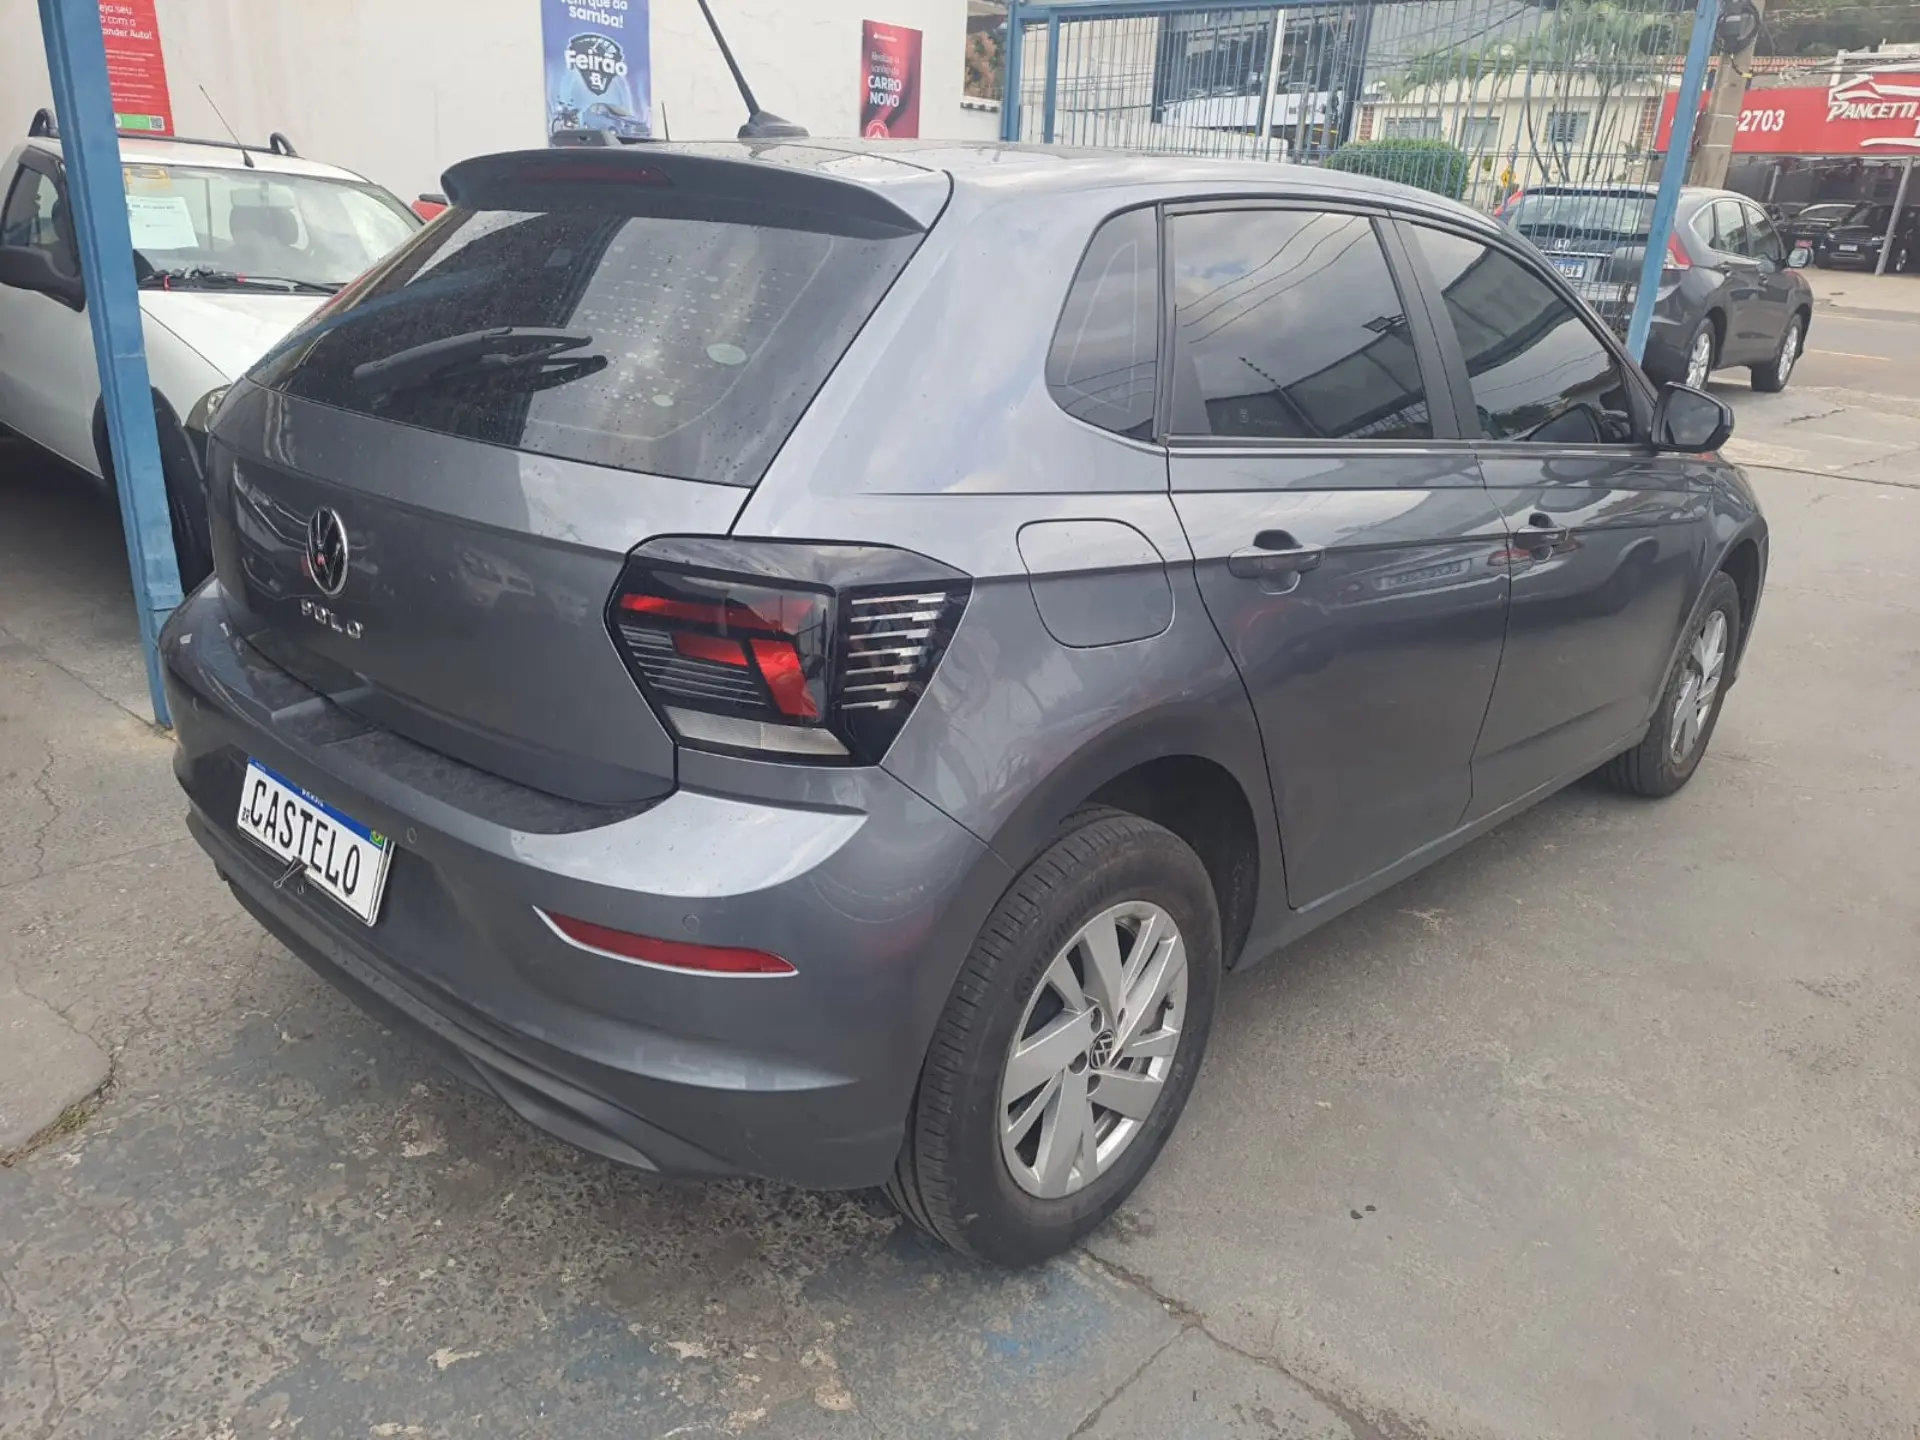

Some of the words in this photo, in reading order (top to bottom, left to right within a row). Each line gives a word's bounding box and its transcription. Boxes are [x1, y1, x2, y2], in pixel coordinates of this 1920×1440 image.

[568, 5, 624, 28] samba!
[130, 29, 153, 40] Auto!
[564, 48, 628, 77] Feirão
[867, 75, 902, 93] CARRO
[869, 91, 900, 108] NOVO
[1825, 100, 1919, 123] PANCETTI
[300, 599, 364, 639] POLO
[250, 779, 361, 897] CASTELO
